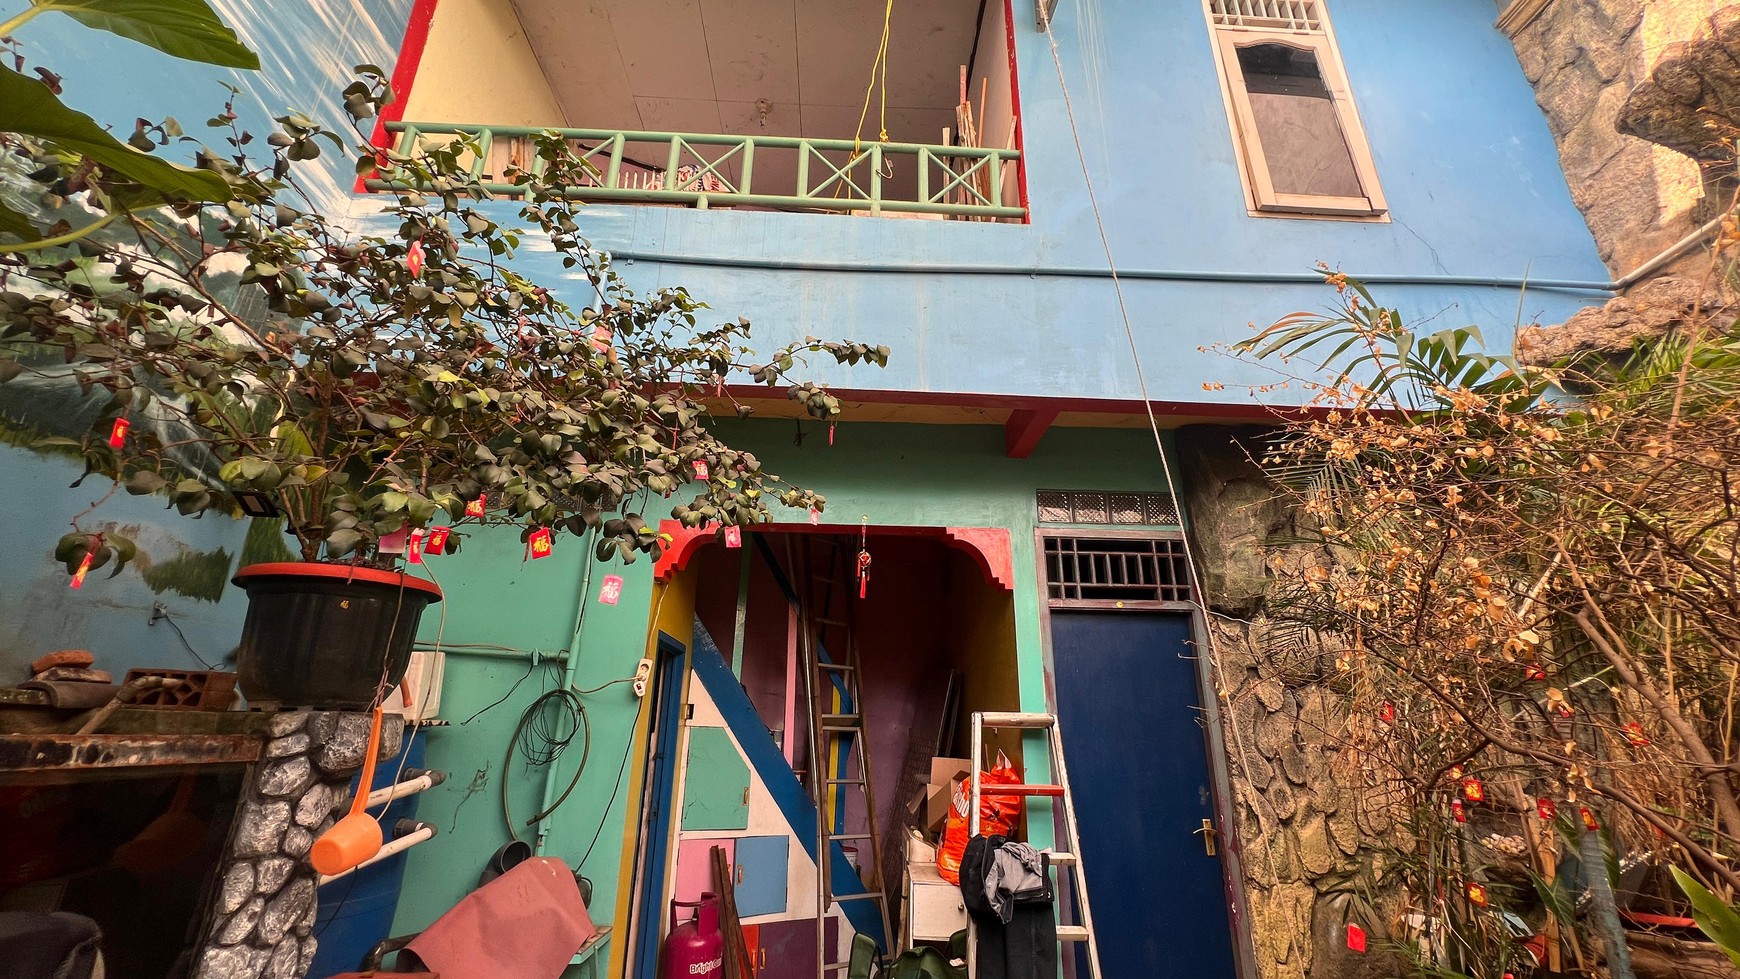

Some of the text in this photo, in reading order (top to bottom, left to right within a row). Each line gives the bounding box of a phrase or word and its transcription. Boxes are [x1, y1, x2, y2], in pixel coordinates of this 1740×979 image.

[467, 499, 483, 513] 福
[533, 535, 550, 552] 福
[601, 581, 618, 599] 福
[690, 961, 713, 974] Bright
